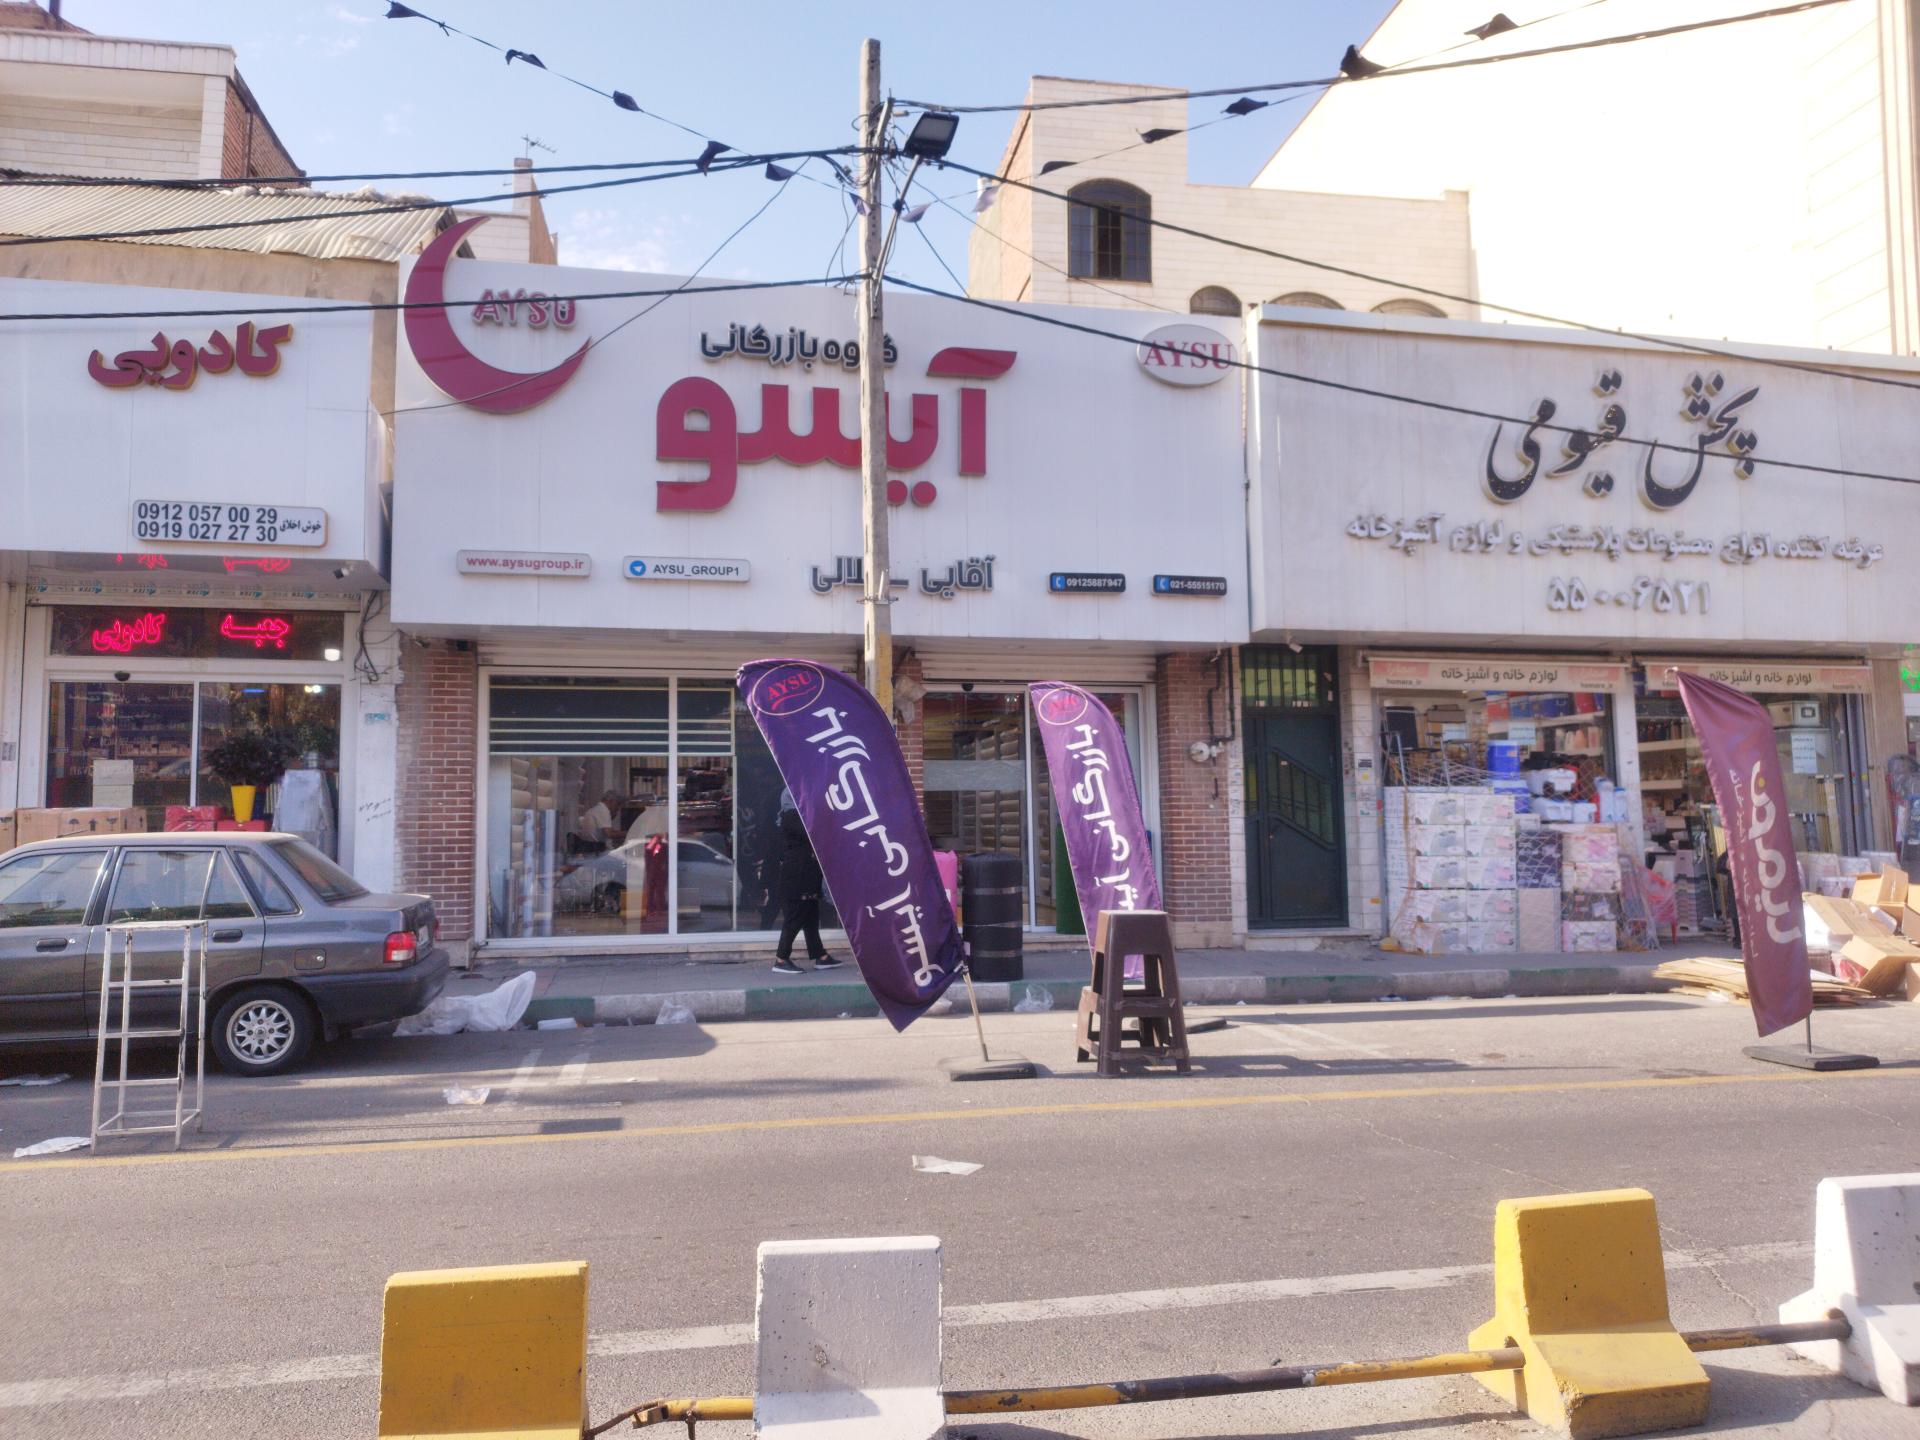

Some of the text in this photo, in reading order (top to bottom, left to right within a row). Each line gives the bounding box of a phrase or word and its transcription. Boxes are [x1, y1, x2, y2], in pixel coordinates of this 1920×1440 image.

[473, 289, 576, 329] AYSU
[88, 320, 293, 391] کادویی
[700, 322, 898, 370] گوه بازرگانی
[1144, 340, 1233, 370] AYSU
[656, 346, 1018, 513] آیسو
[1482, 367, 1761, 511] پخش قیومی
[137, 502, 278, 525] 0912 057 00 29
[137, 520, 278, 543] 0919 027 27 30
[280, 519, 321, 534] خوش اخلاق
[466, 556, 585, 571] www.aysugroup.ir
[653, 564, 740, 577] AYSU_GROUP1
[811, 555, 996, 598] آقایی لالی
[92, 611, 290, 653] جعبه کادویی
[767, 671, 814, 701] AYSU
[805, 706, 910, 877] بازرگانی
[1065, 724, 1130, 862] بازرگانی
